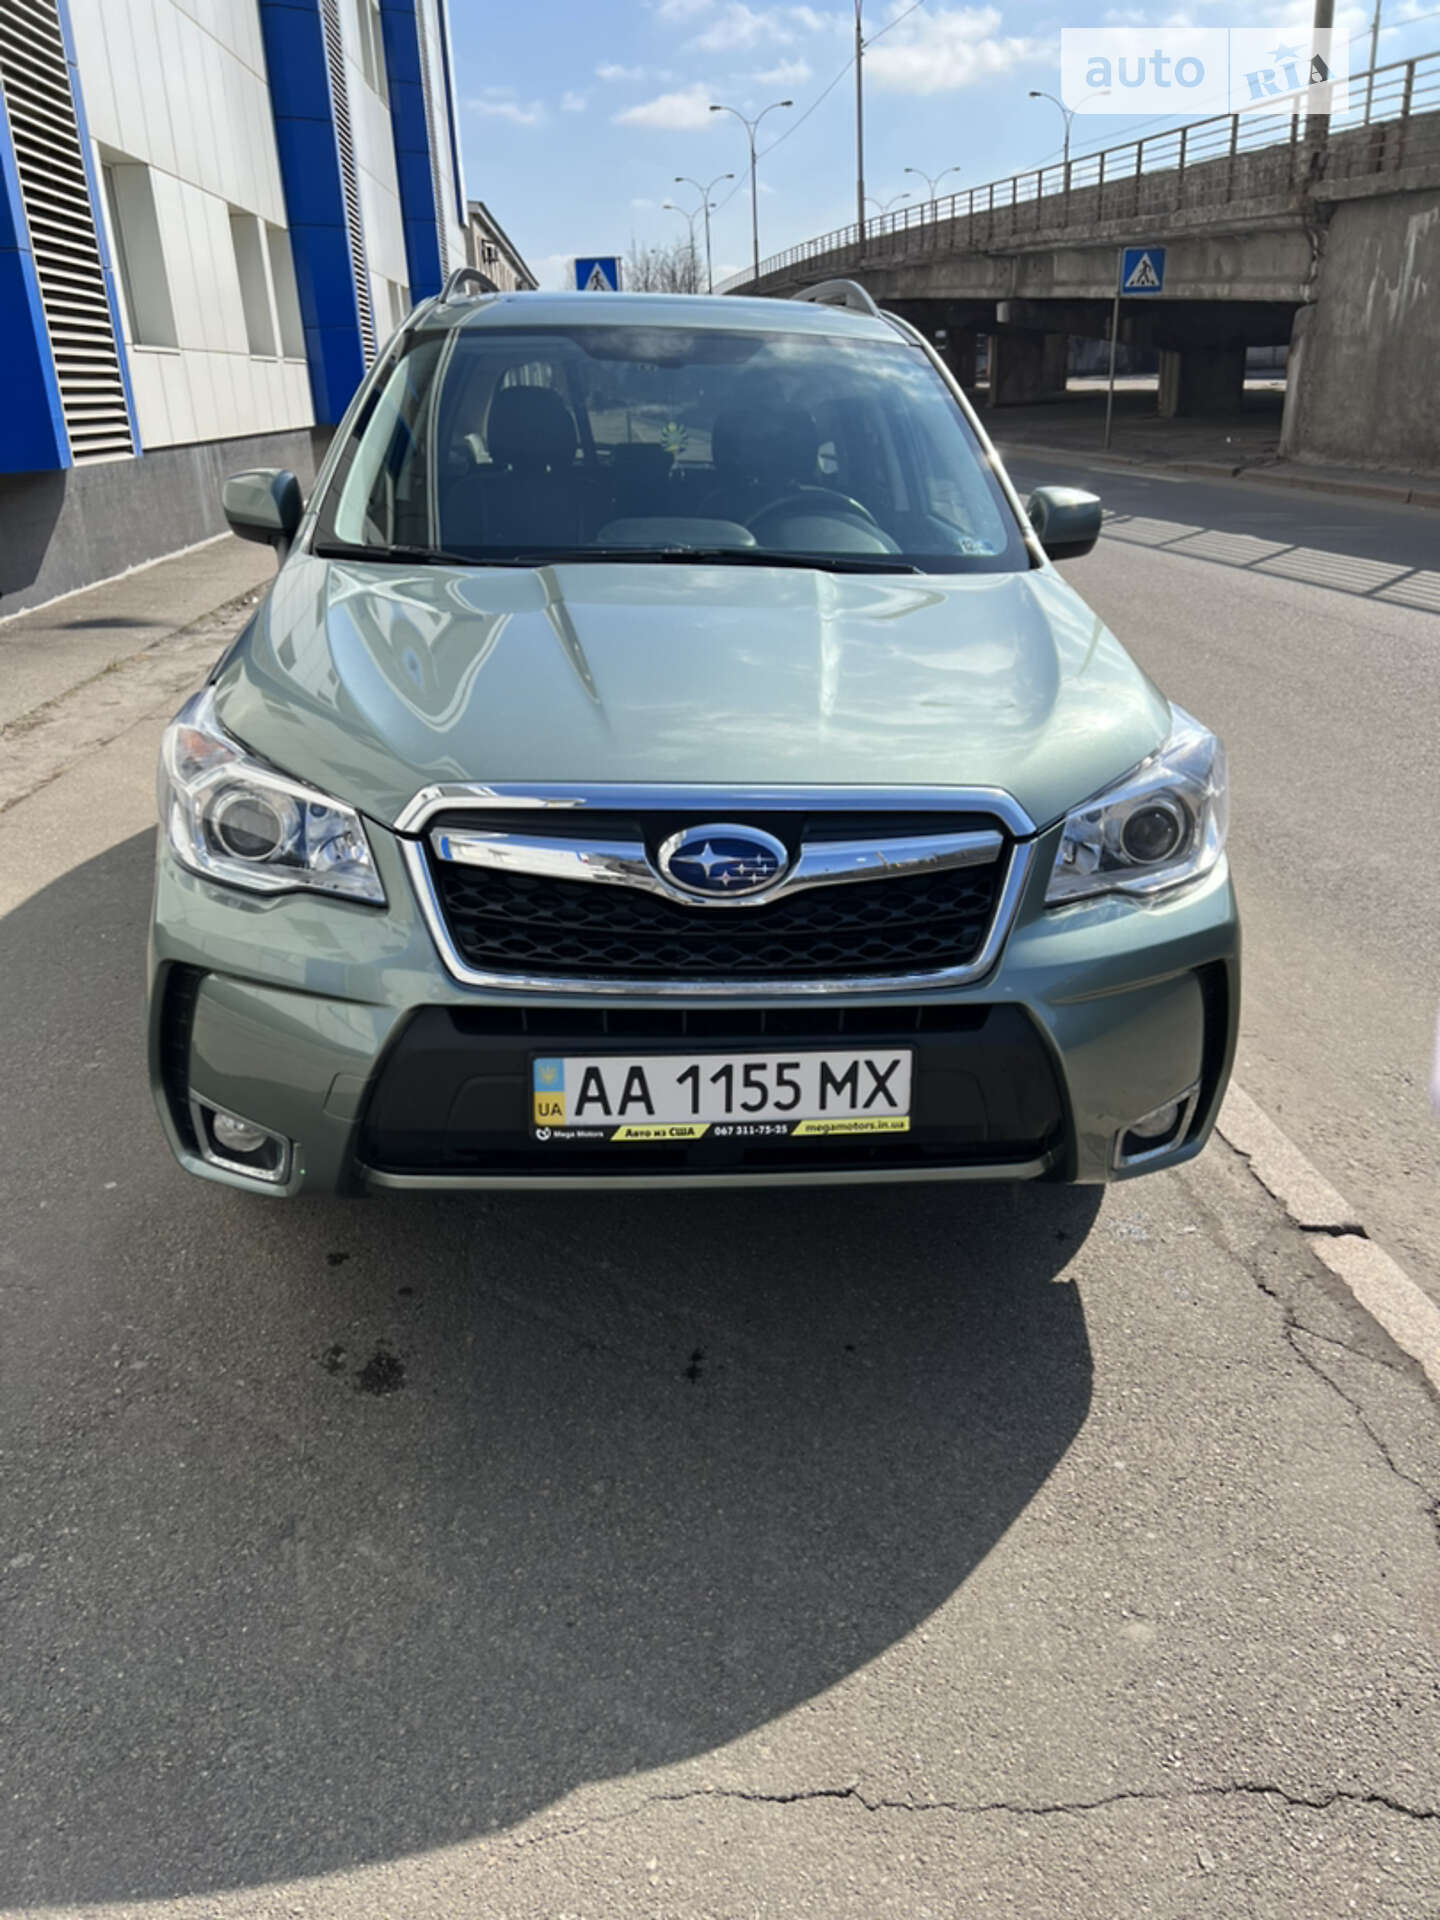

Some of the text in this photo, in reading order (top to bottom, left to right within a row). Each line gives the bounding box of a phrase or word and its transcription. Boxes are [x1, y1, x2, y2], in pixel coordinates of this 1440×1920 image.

[574, 1059, 901, 1116] AA 1155 MX
[538, 1103, 563, 1116] UA
[625, 1128, 650, 1138] Авто
[668, 1127, 695, 1137] США
[714, 1126, 733, 1136] 067
[805, 1121, 905, 1135] megamotors.in.ua
